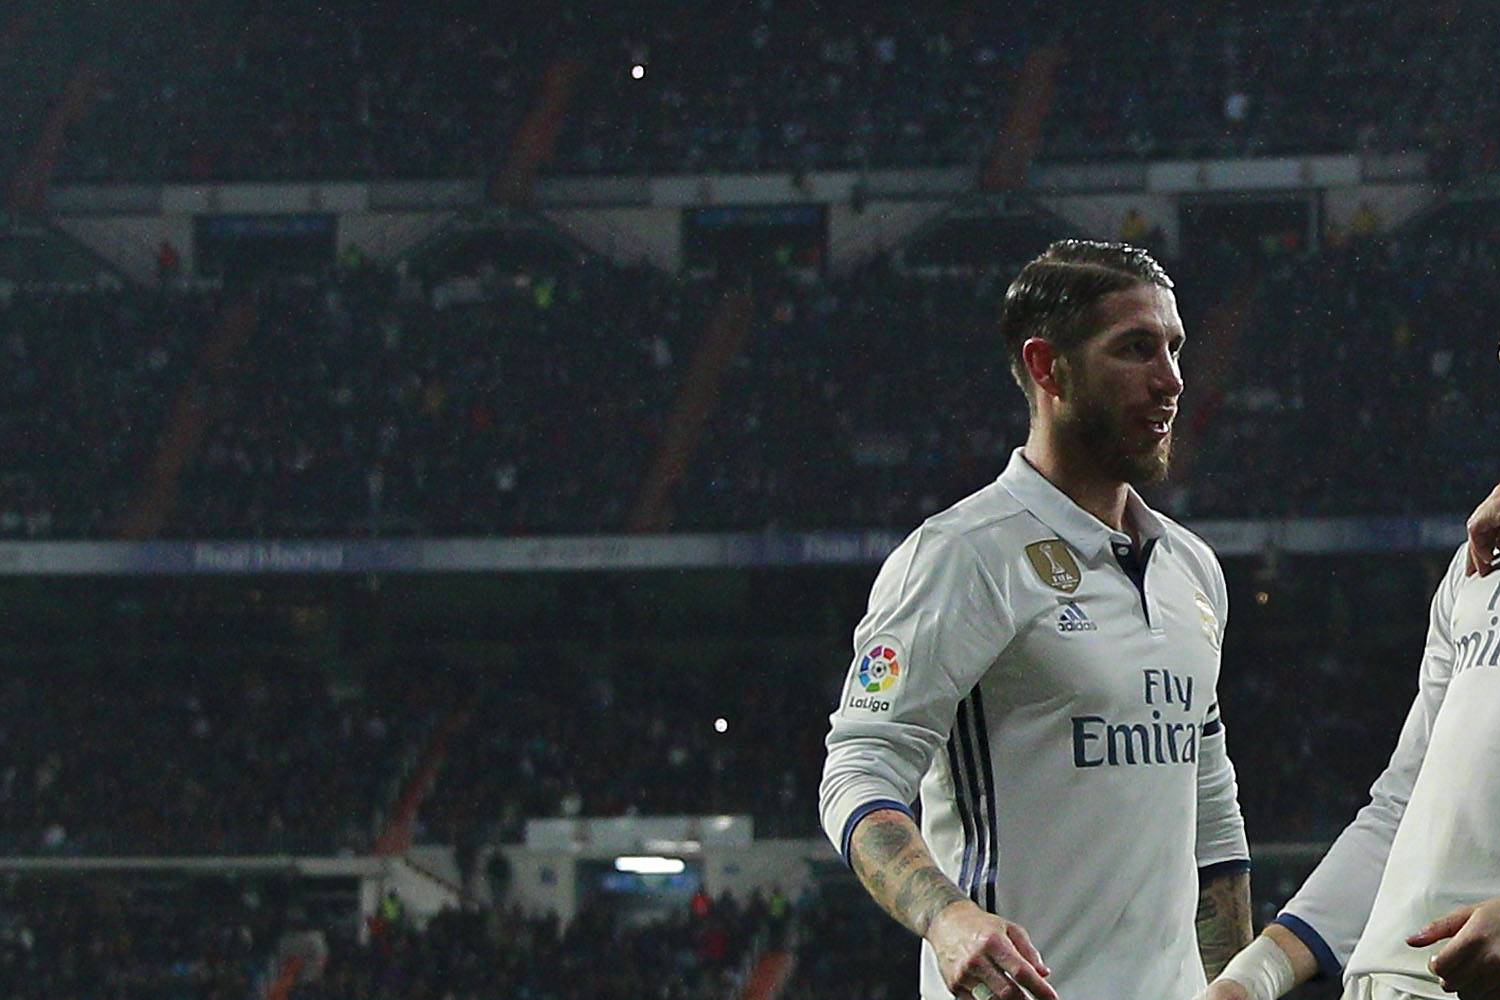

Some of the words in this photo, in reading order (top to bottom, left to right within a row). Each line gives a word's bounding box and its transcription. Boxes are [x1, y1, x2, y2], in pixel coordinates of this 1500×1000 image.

[849, 696, 890, 713] LaLiga
[1143, 669, 1192, 711] Fly
[1071, 710, 1199, 768] Emira
